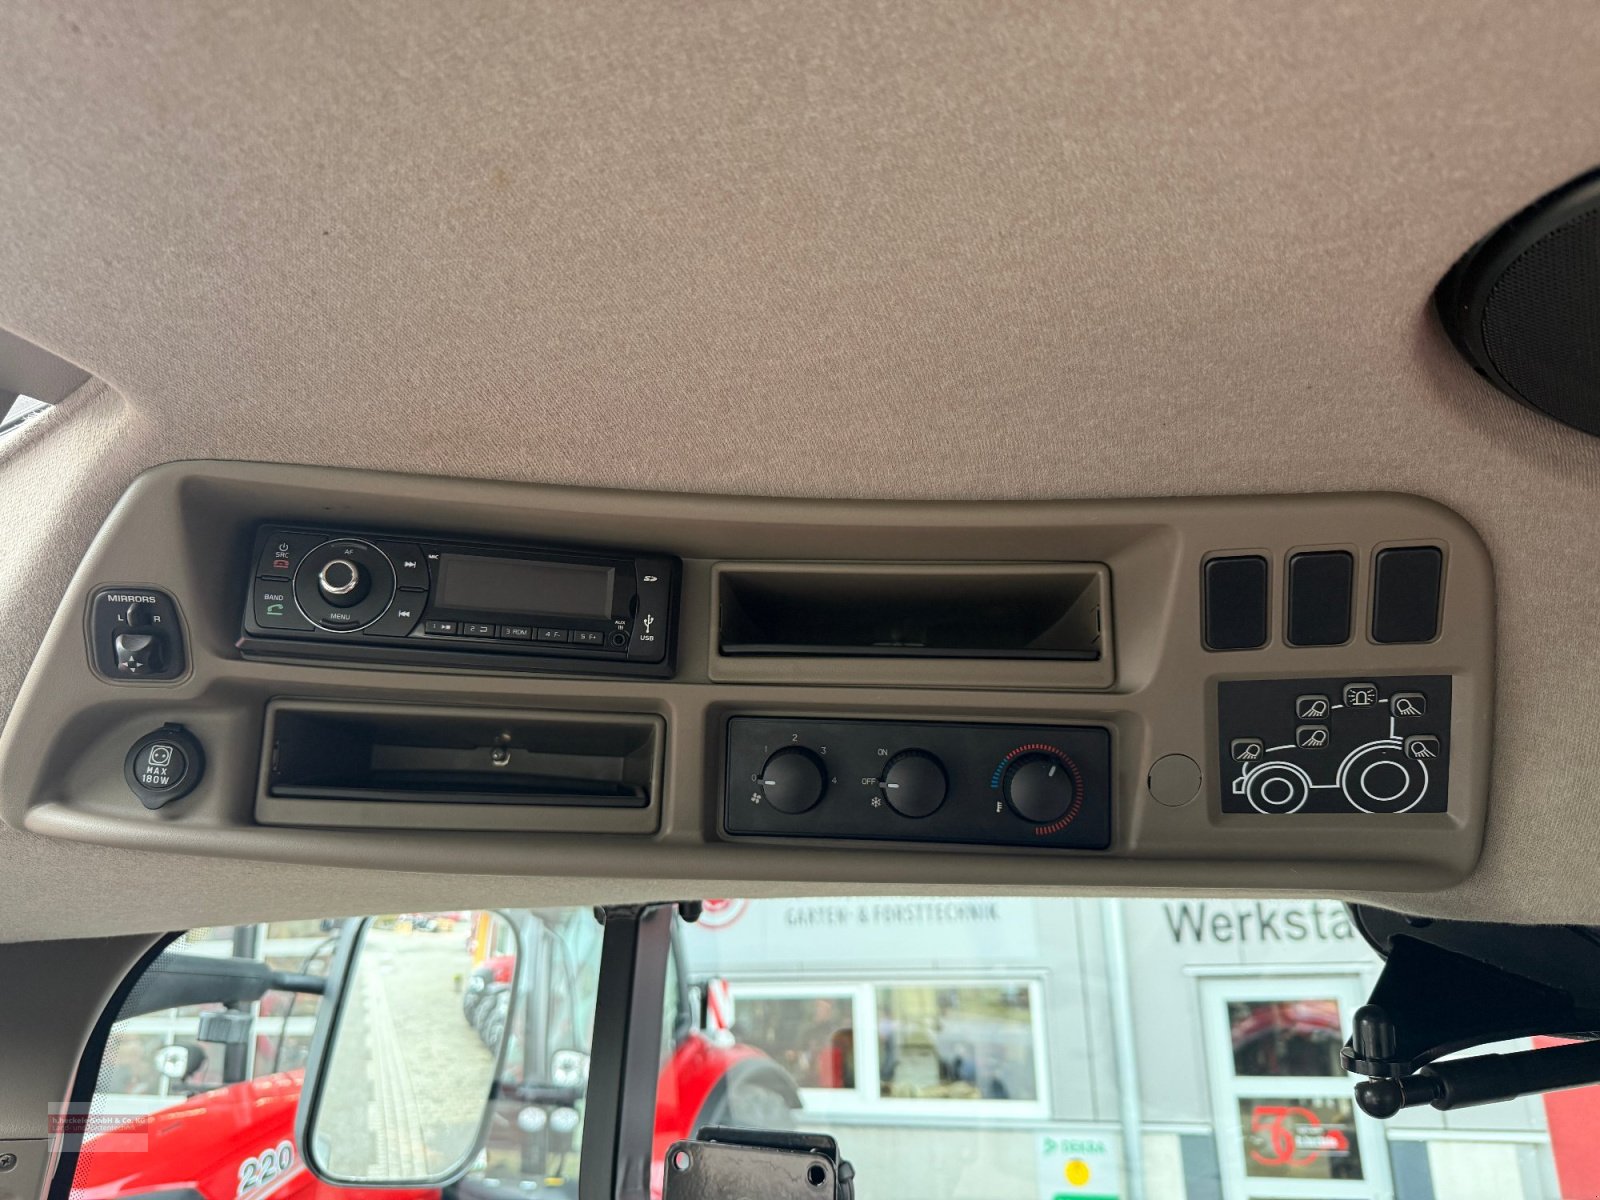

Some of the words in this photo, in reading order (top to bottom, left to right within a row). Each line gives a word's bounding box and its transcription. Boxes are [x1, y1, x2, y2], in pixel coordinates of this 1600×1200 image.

[275, 551, 289, 559] SRC
[107, 594, 156, 603] MIRRORS
[264, 593, 284, 601] BAND
[117, 614, 124, 622] L
[153, 615, 161, 623] R
[330, 612, 351, 620] MENU
[640, 634, 655, 642] USB
[791, 733, 798, 742] 2
[820, 746, 827, 755] 3
[877, 748, 889, 756] ON
[146, 767, 168, 776] MAX
[141, 775, 170, 785] 180W
[751, 774, 758, 783] 0
[831, 776, 838, 785] 4
[861, 777, 877, 786] OFF
[238, 1141, 293, 1190] 220
